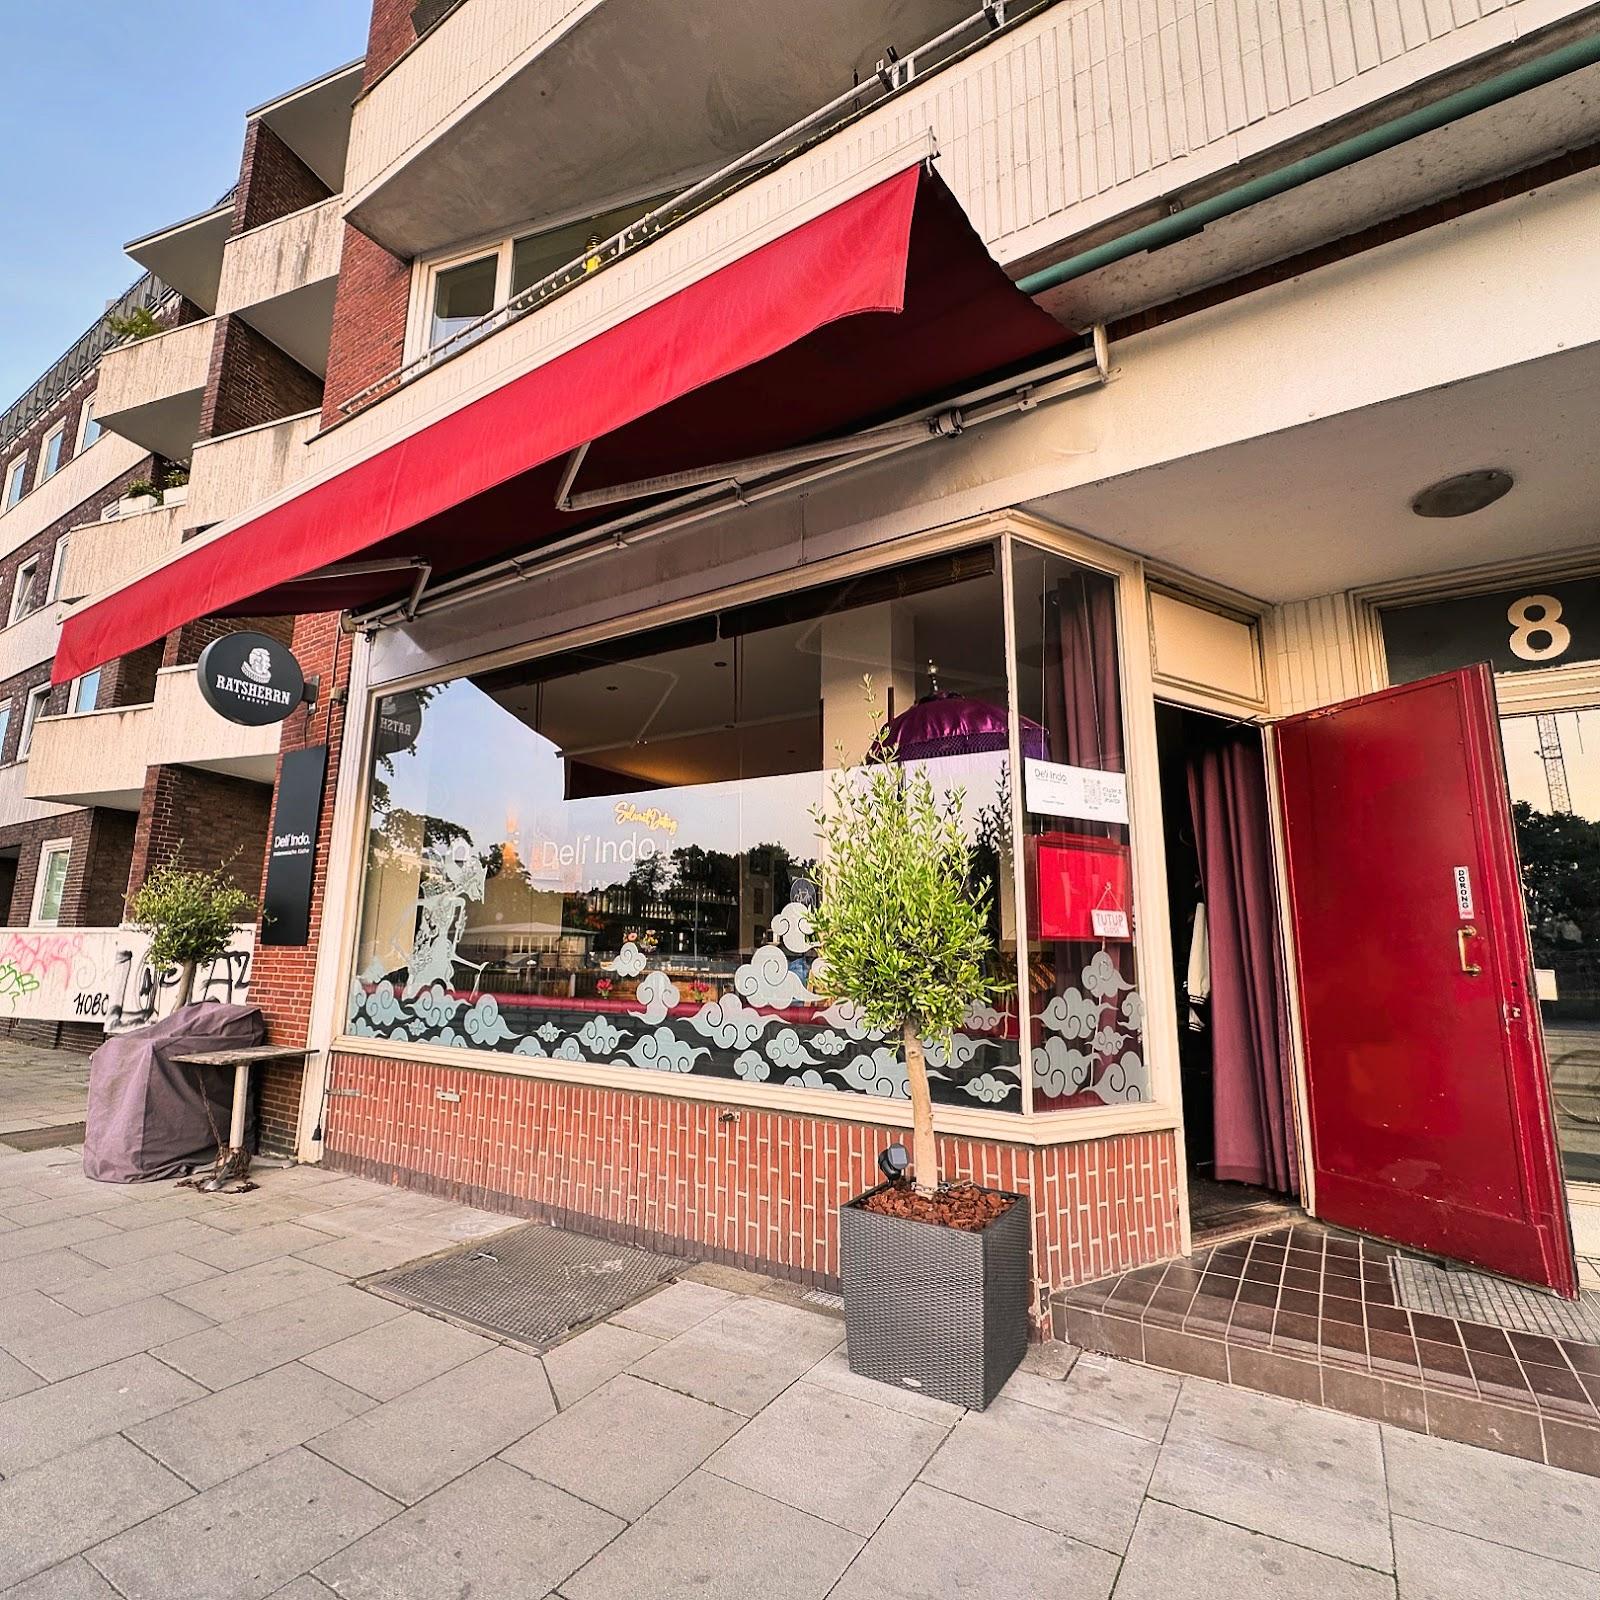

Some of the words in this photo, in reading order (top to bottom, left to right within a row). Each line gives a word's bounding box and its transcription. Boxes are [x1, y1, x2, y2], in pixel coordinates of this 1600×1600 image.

[1507, 594, 1571, 661] 8
[215, 674, 291, 705] RATSHERRN
[1458, 869, 1469, 909] DORONG
[1095, 913, 1124, 927] TUTUP
